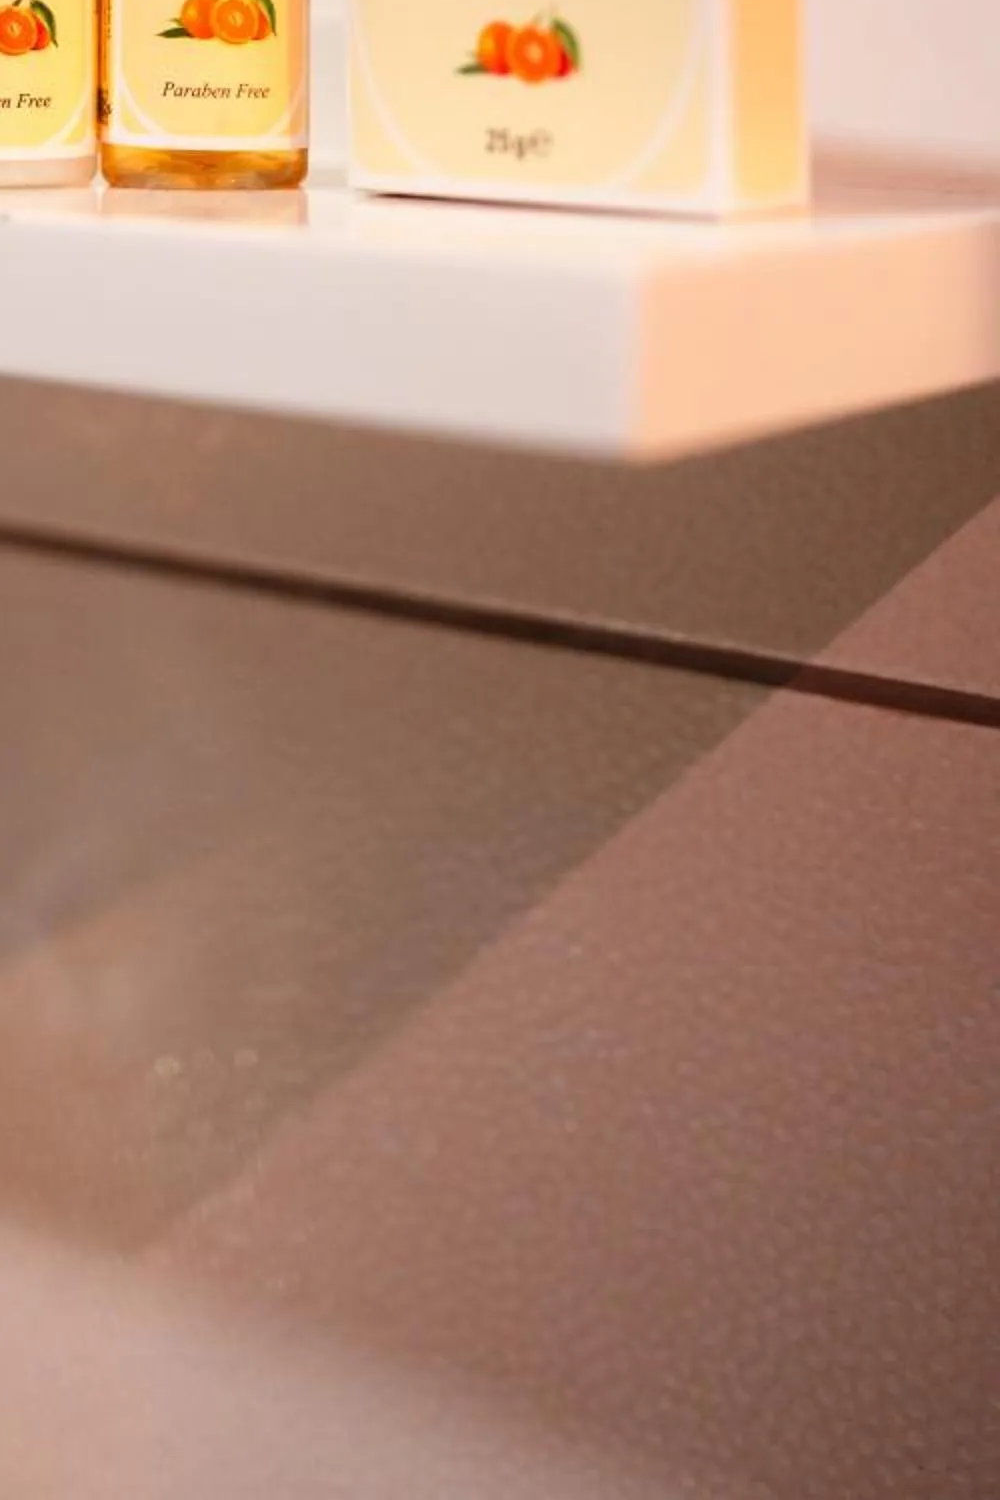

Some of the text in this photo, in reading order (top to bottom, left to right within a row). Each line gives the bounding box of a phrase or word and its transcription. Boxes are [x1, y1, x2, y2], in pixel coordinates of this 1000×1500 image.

[161, 80, 272, 100] Paraben Free
[15, 92, 52, 109] Free
